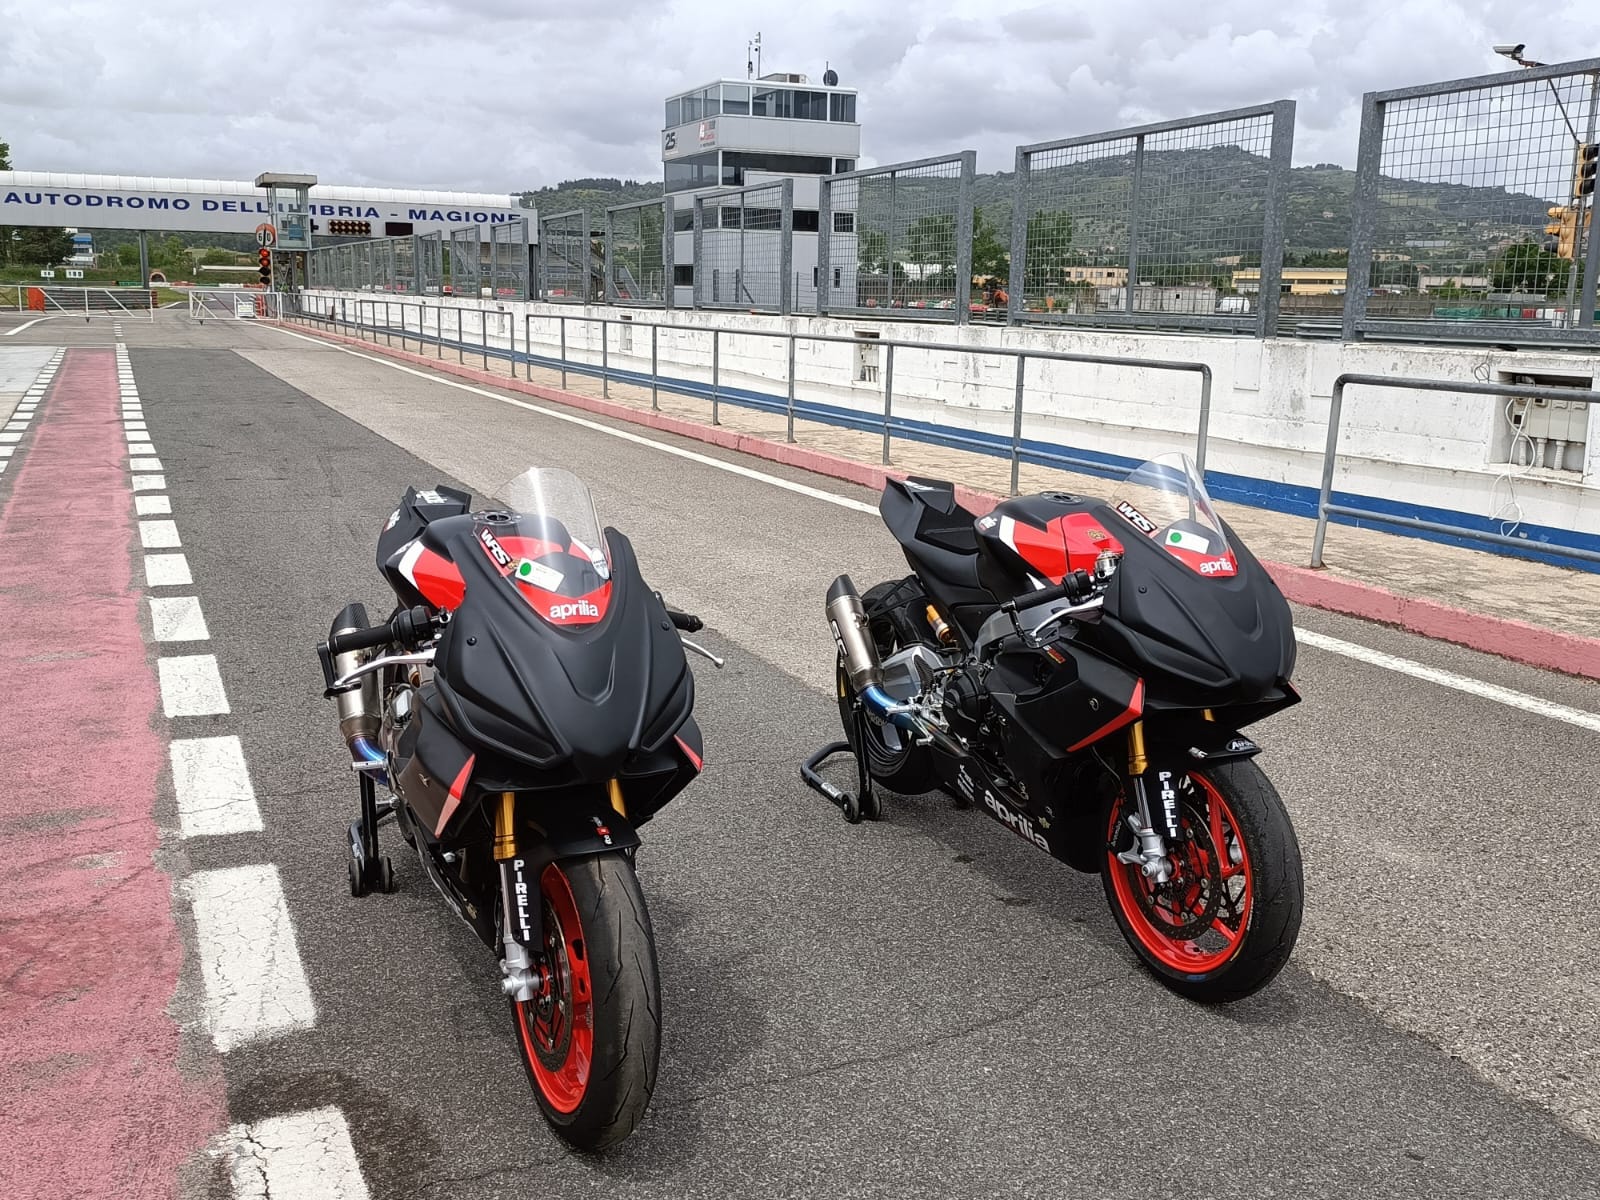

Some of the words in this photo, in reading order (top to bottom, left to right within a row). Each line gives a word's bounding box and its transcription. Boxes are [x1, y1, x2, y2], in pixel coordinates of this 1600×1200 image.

[665, 132, 676, 150] 25
[4, 192, 190, 211] AUTODROMO
[1118, 502, 1158, 532] WRS
[481, 528, 512, 566] WRS
[549, 600, 599, 619] aprilia
[984, 789, 1051, 854] aprilia
[1158, 771, 1178, 838] PIRELLI
[513, 859, 531, 941] PIRELLI
